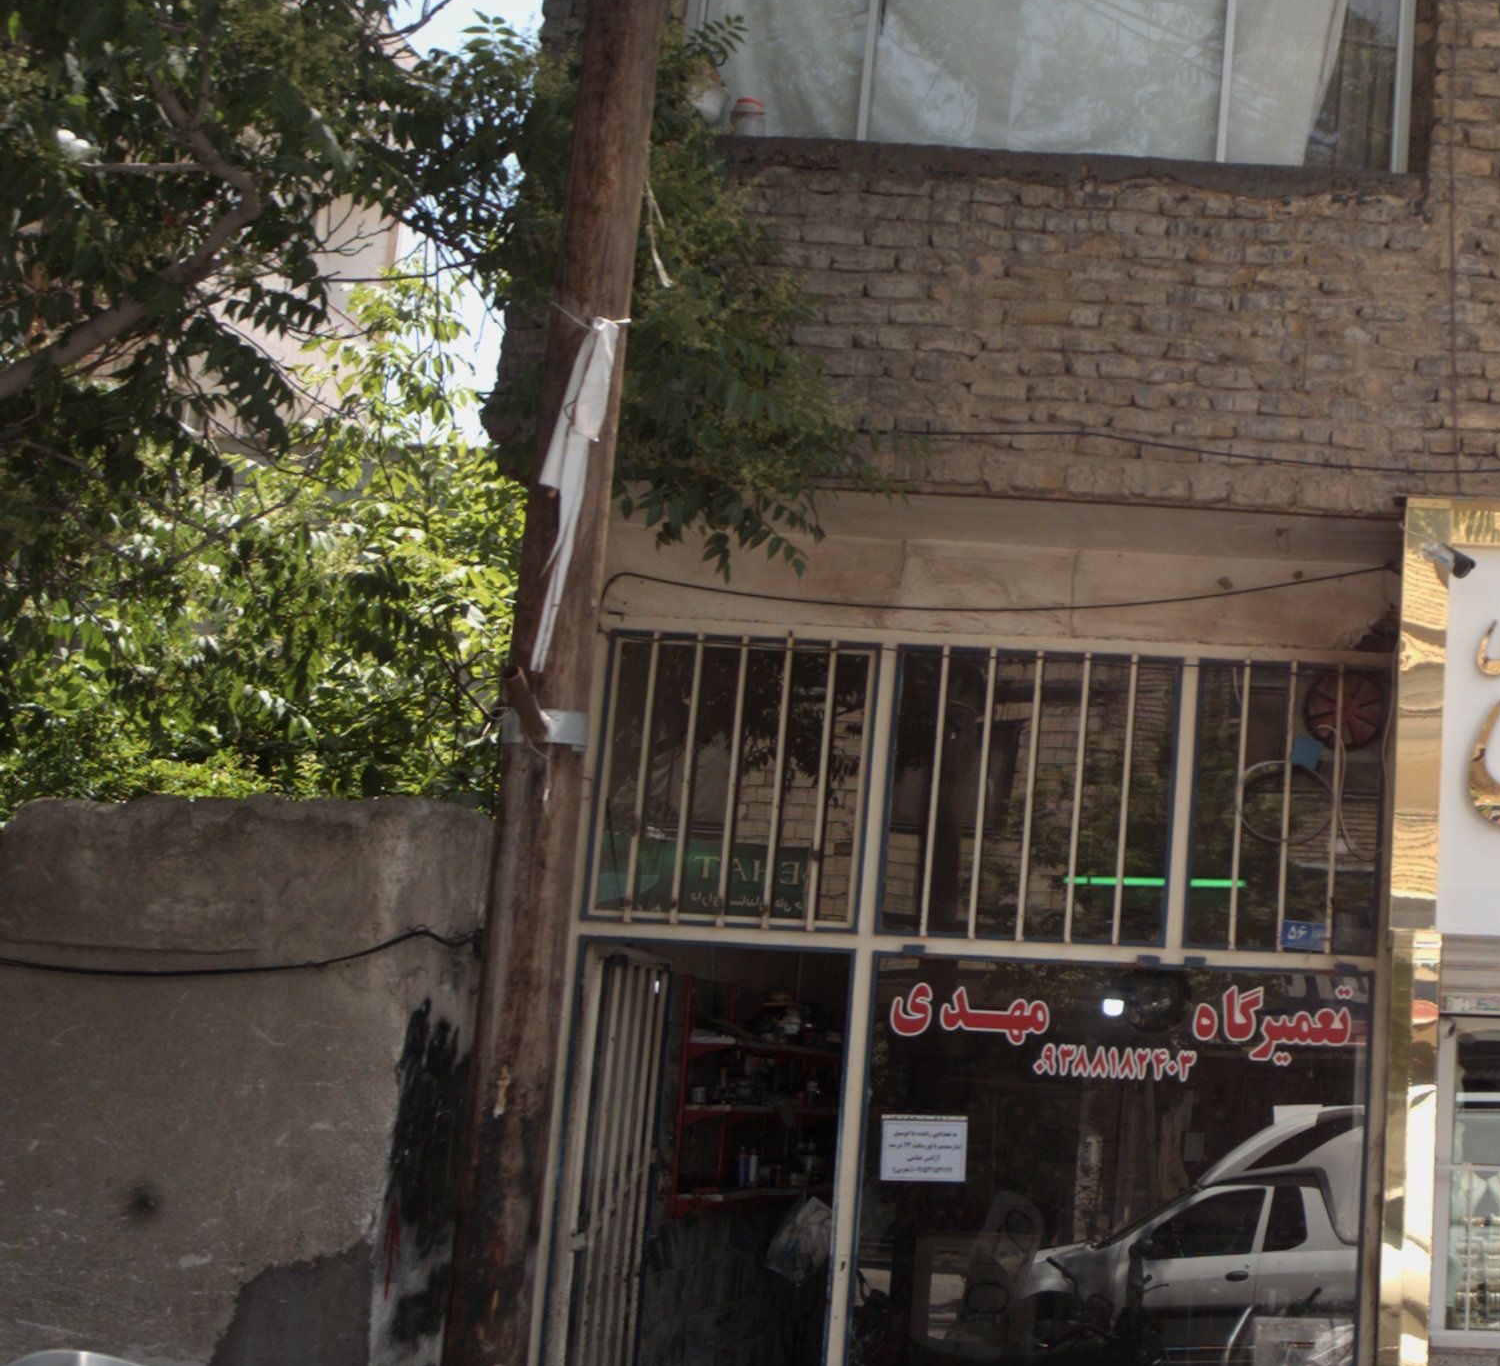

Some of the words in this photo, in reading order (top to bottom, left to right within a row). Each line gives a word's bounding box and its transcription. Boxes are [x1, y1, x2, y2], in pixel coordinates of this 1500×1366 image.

[890, 982, 1050, 1046] مهدی
[1192, 984, 1352, 1066] تعمیرگاه
[1033, 1042, 1198, 1082] ۰۹۳۸۸۱۸۲۴۰۳
